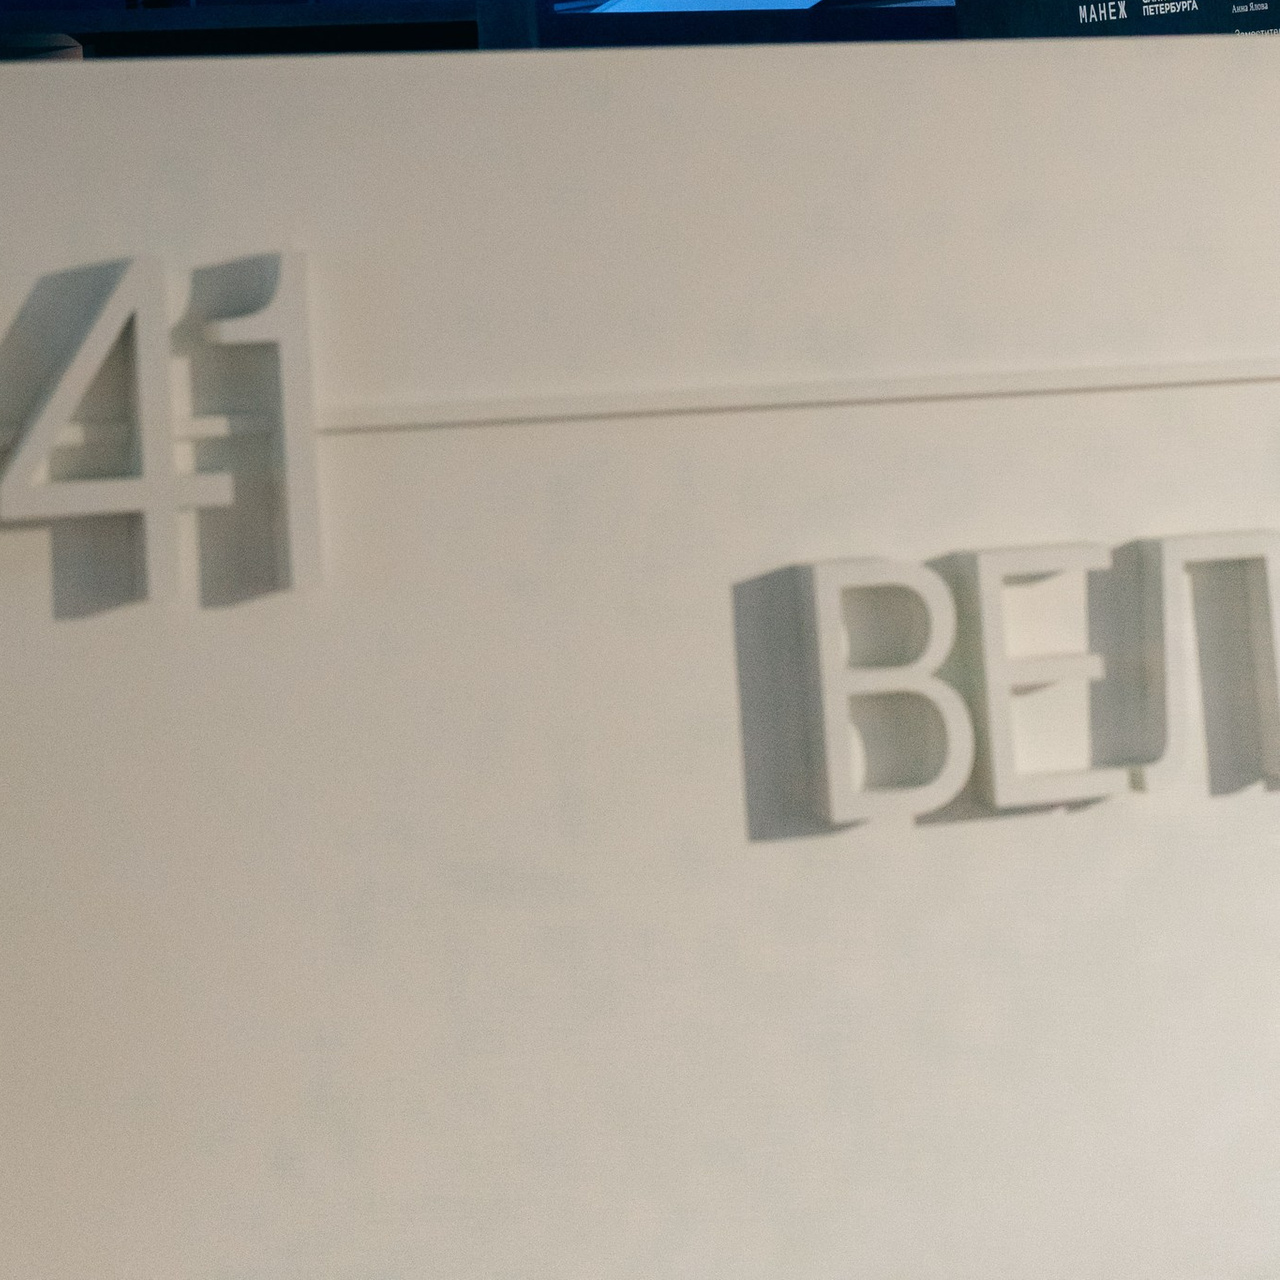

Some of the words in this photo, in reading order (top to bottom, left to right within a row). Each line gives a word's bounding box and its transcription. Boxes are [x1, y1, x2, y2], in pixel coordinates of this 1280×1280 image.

[1079, 0, 1127, 24] МАНЕЖ
[1142, 0, 1199, 16] ПЕТЕРБУРГА
[1232, 4, 1248, 13] Анна
[1249, 2, 1269, 11] Ялова
